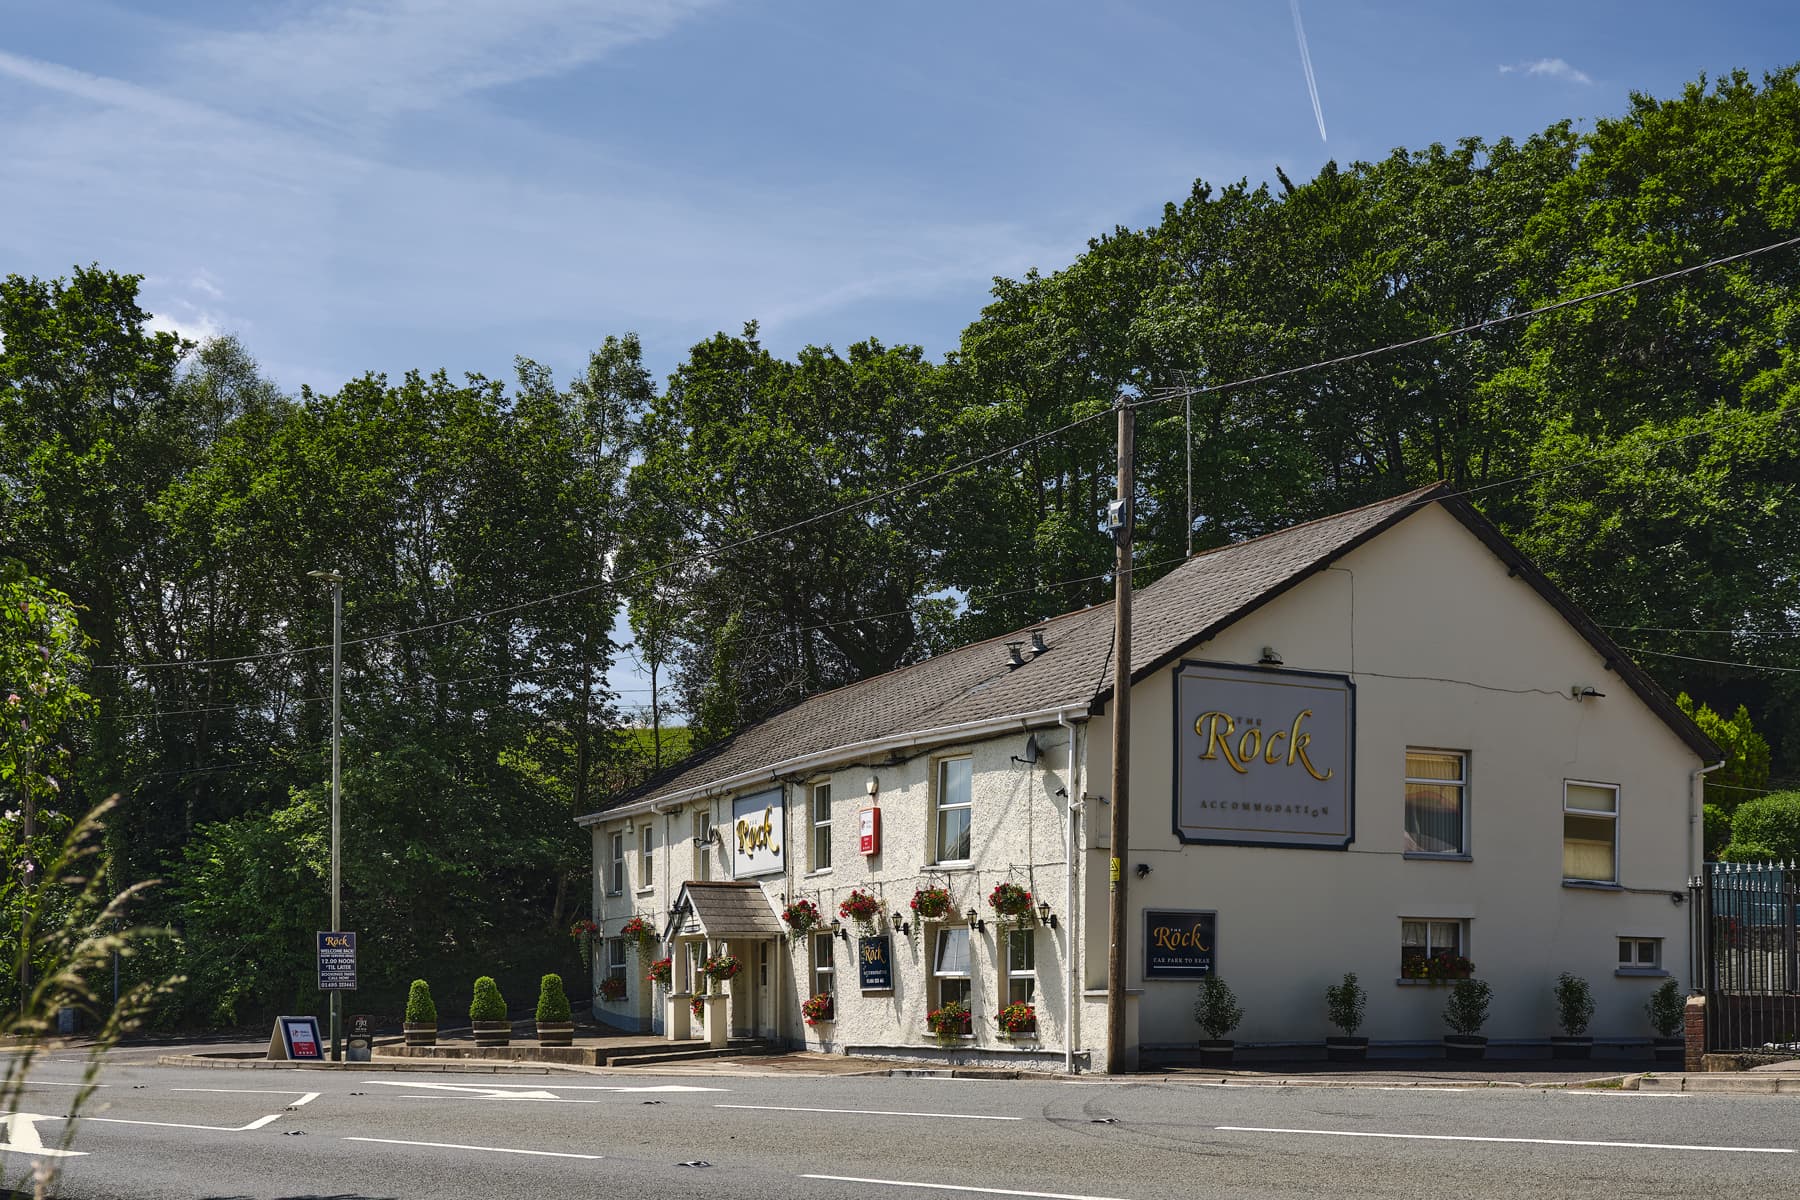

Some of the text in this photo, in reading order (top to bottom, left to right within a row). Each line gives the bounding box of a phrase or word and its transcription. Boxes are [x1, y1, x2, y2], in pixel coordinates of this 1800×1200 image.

[1236, 717, 1262, 726] THE
[1194, 709, 1334, 781] Rock
[1200, 800, 1329, 817] ACCOMMODATION
[736, 804, 780, 858] Rock
[325, 935, 350, 947] Rock
[1153, 923, 1210, 952] Rock
[864, 943, 887, 965] Rock
